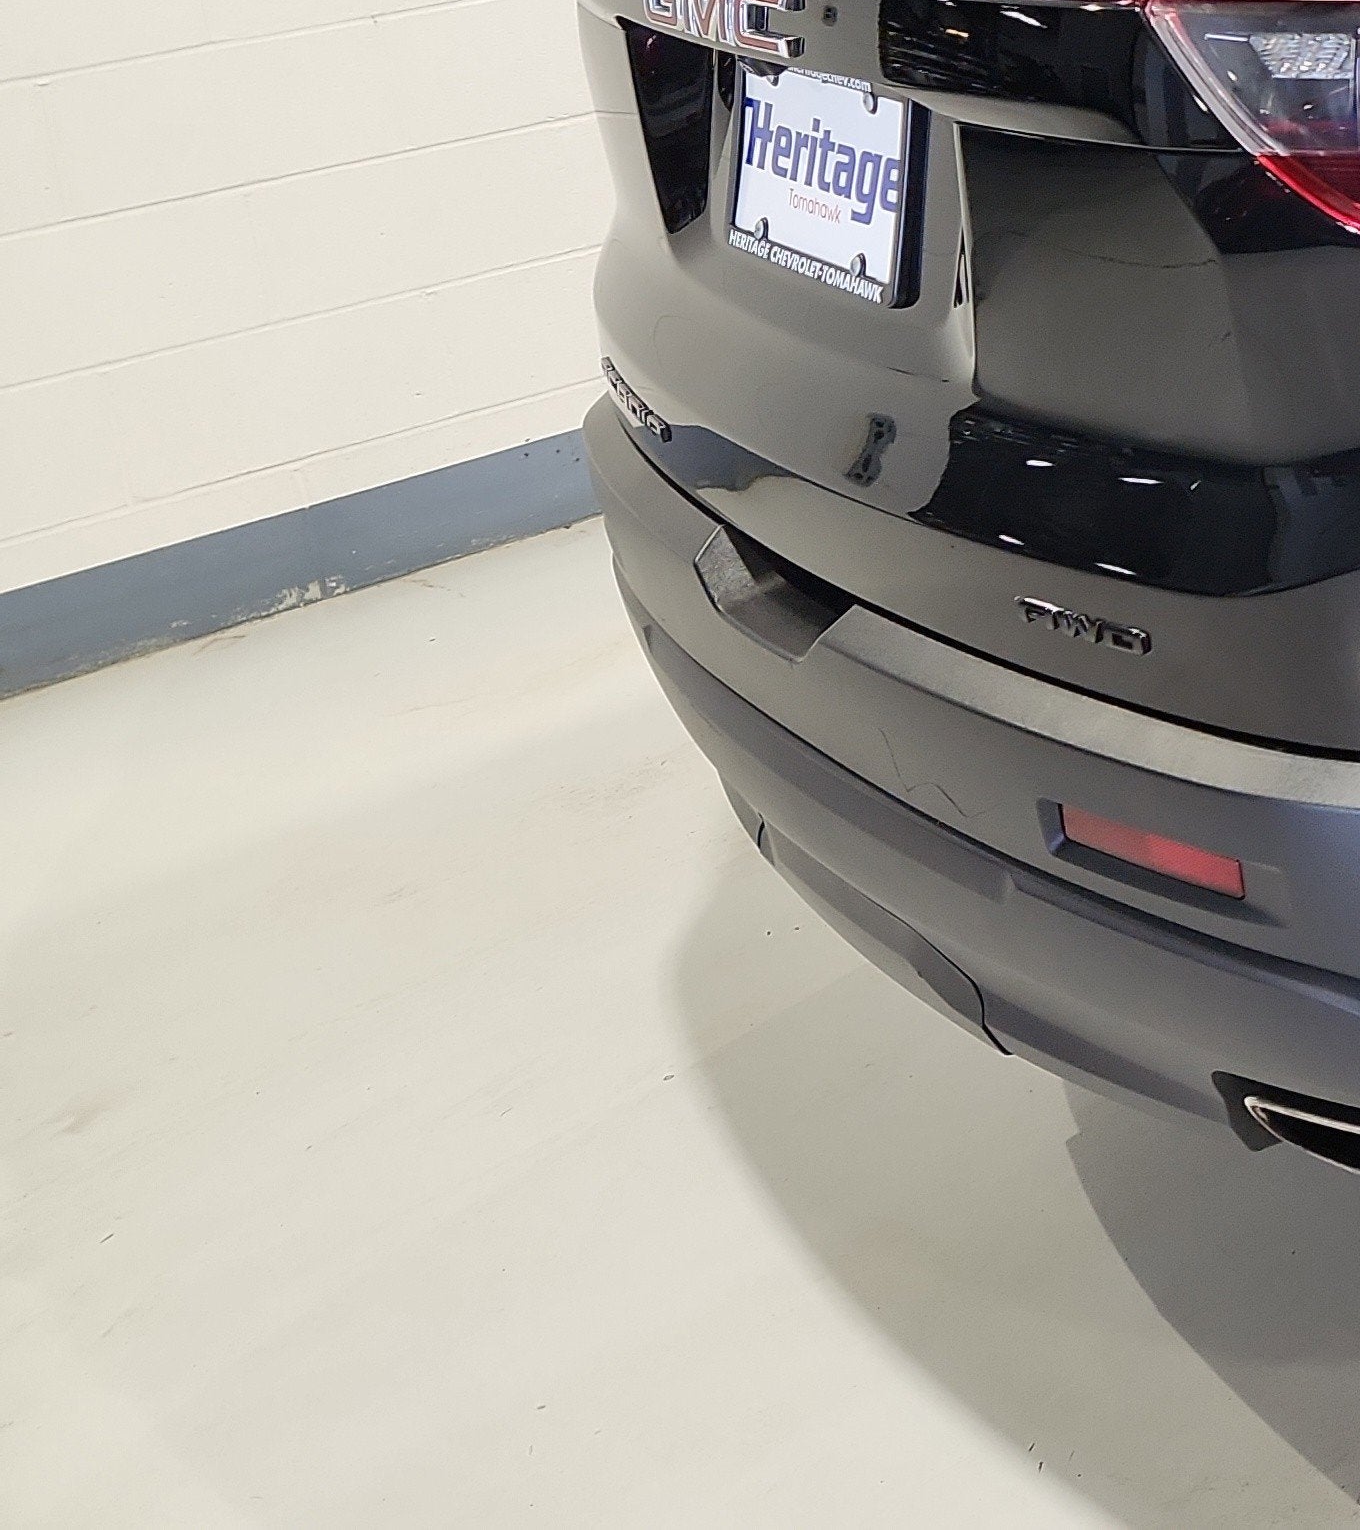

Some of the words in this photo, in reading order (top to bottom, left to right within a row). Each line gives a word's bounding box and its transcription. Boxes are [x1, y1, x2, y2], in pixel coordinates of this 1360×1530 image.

[744, 96, 901, 226] Heritage
[787, 187, 842, 225] Tomahawk
[728, 228, 771, 260] HERITAGE
[769, 244, 885, 306] CHEVROLET-TOMAHAWK
[1013, 594, 1153, 656] AWD
